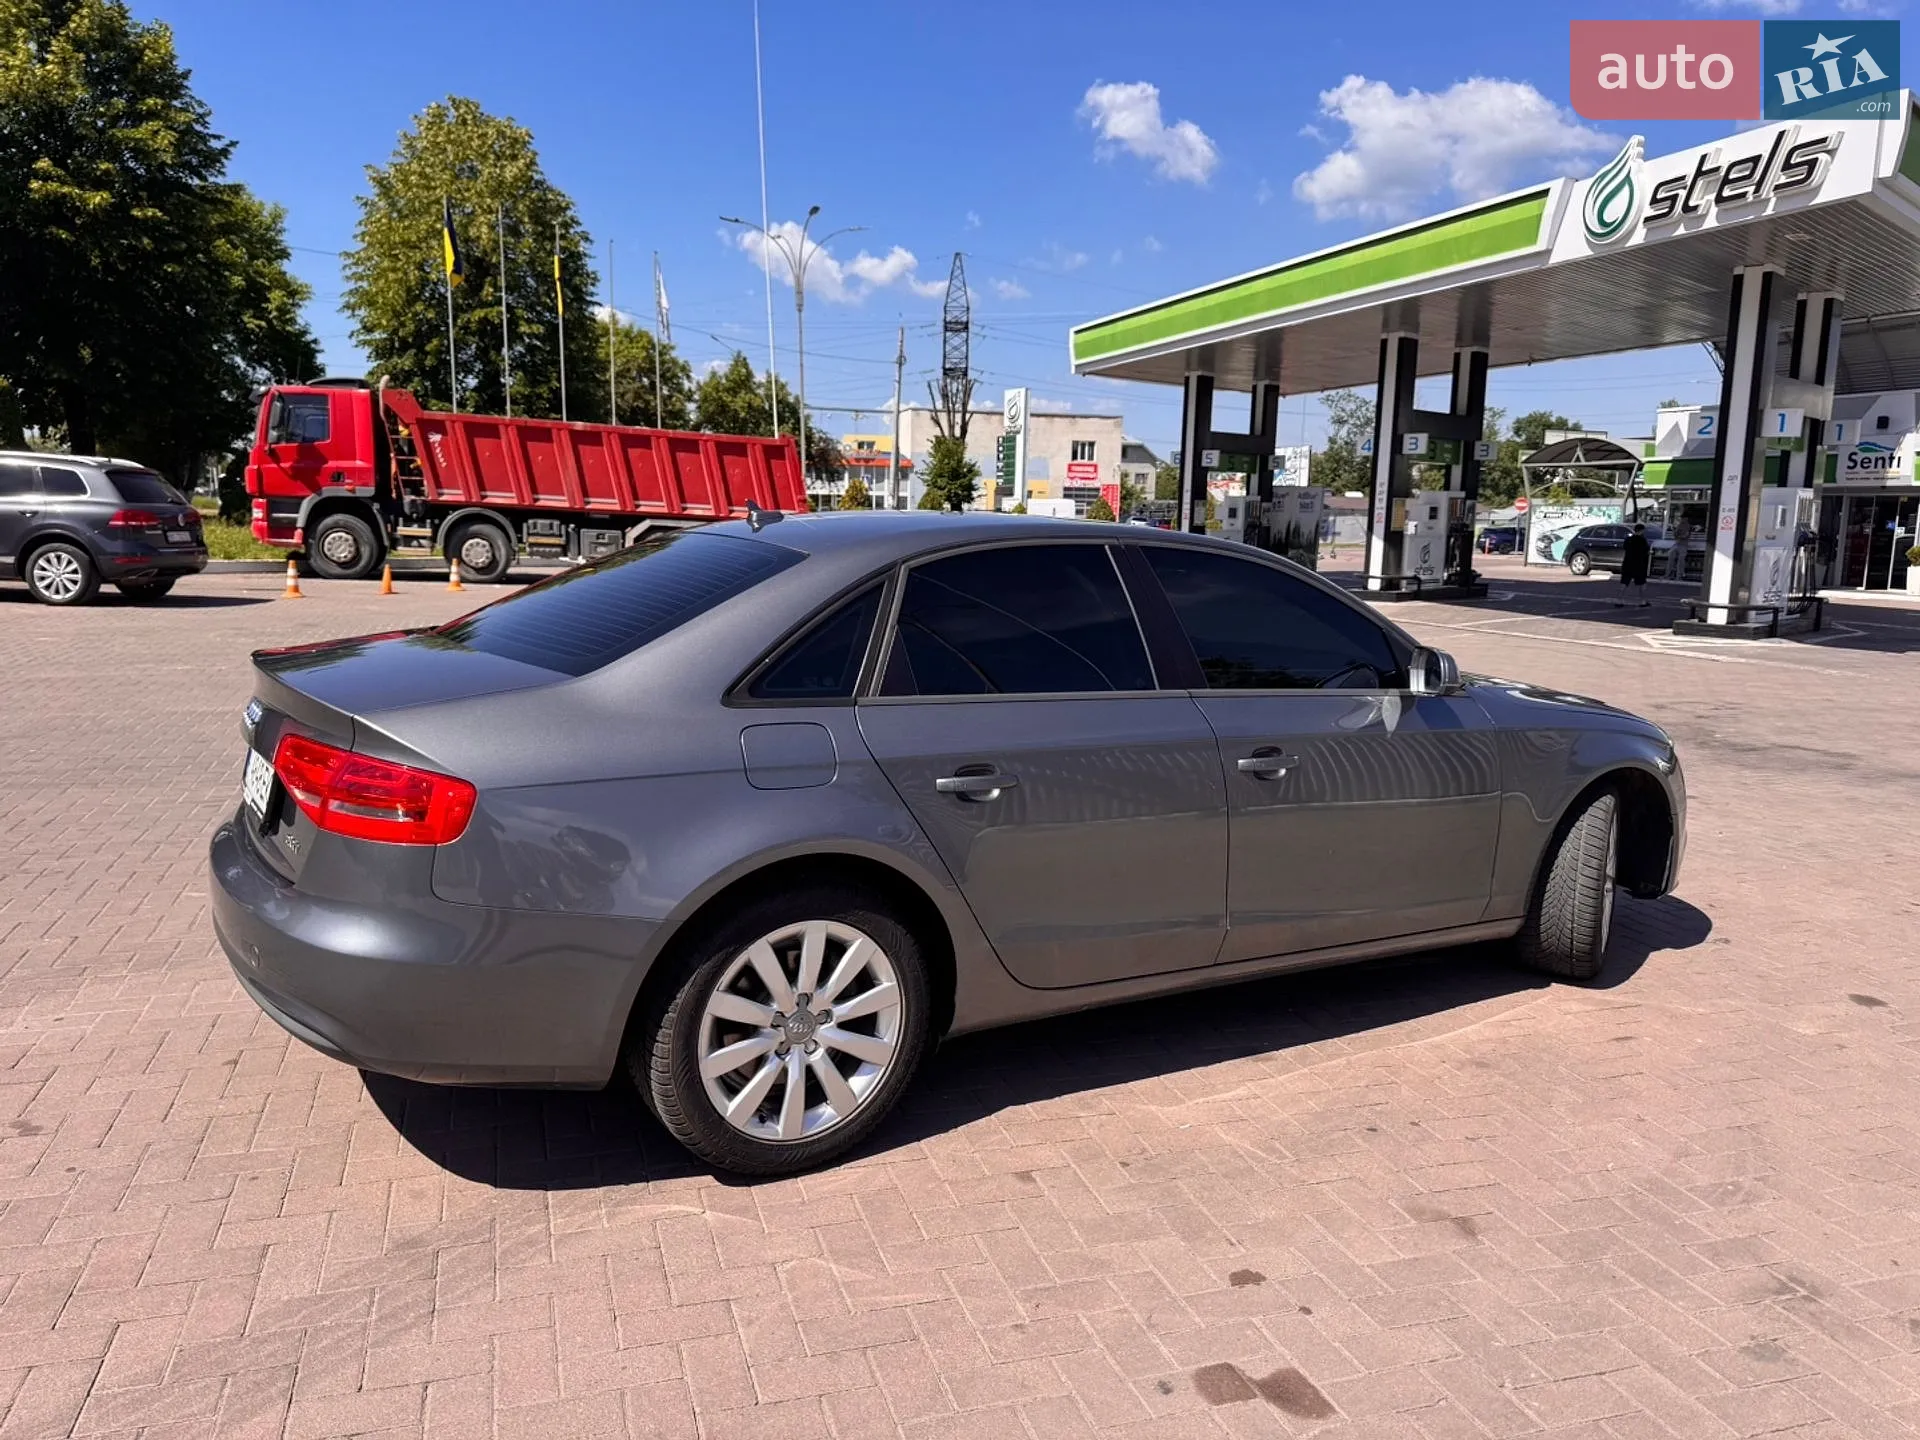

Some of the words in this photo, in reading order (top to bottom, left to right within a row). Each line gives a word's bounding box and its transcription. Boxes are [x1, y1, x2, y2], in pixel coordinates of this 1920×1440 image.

[1643, 125, 1843, 224] stels
[1697, 416, 1714, 435] 2
[1777, 412, 1787, 433] 1
[1836, 423, 1844, 441] 1
[1360, 438, 1372, 453] 4
[1407, 436, 1419, 451] 3
[1479, 443, 1489, 457] 3
